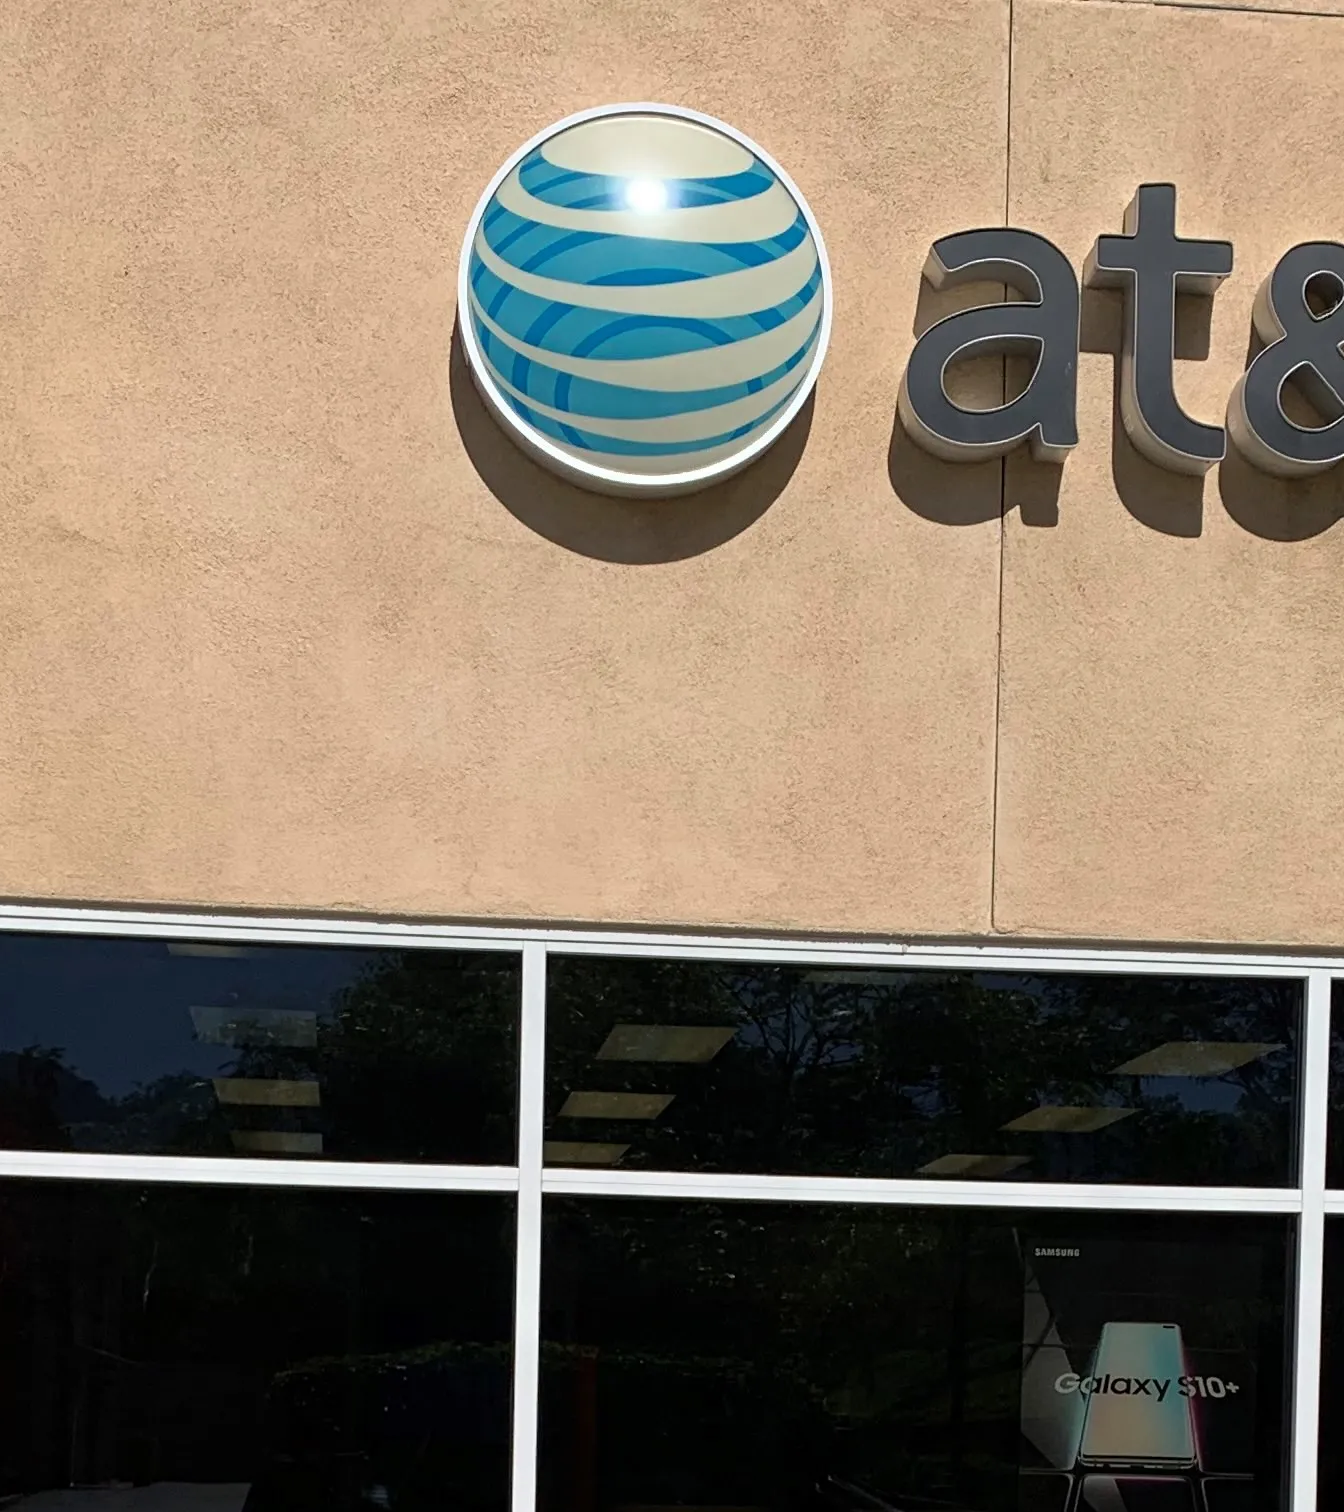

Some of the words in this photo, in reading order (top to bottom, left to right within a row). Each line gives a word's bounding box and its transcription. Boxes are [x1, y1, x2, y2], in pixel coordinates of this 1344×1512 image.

[1034, 1247, 1080, 1257] SAMSUNG
[1054, 1372, 1171, 1403] Galaxy
[1177, 1375, 1240, 1399] S10+
